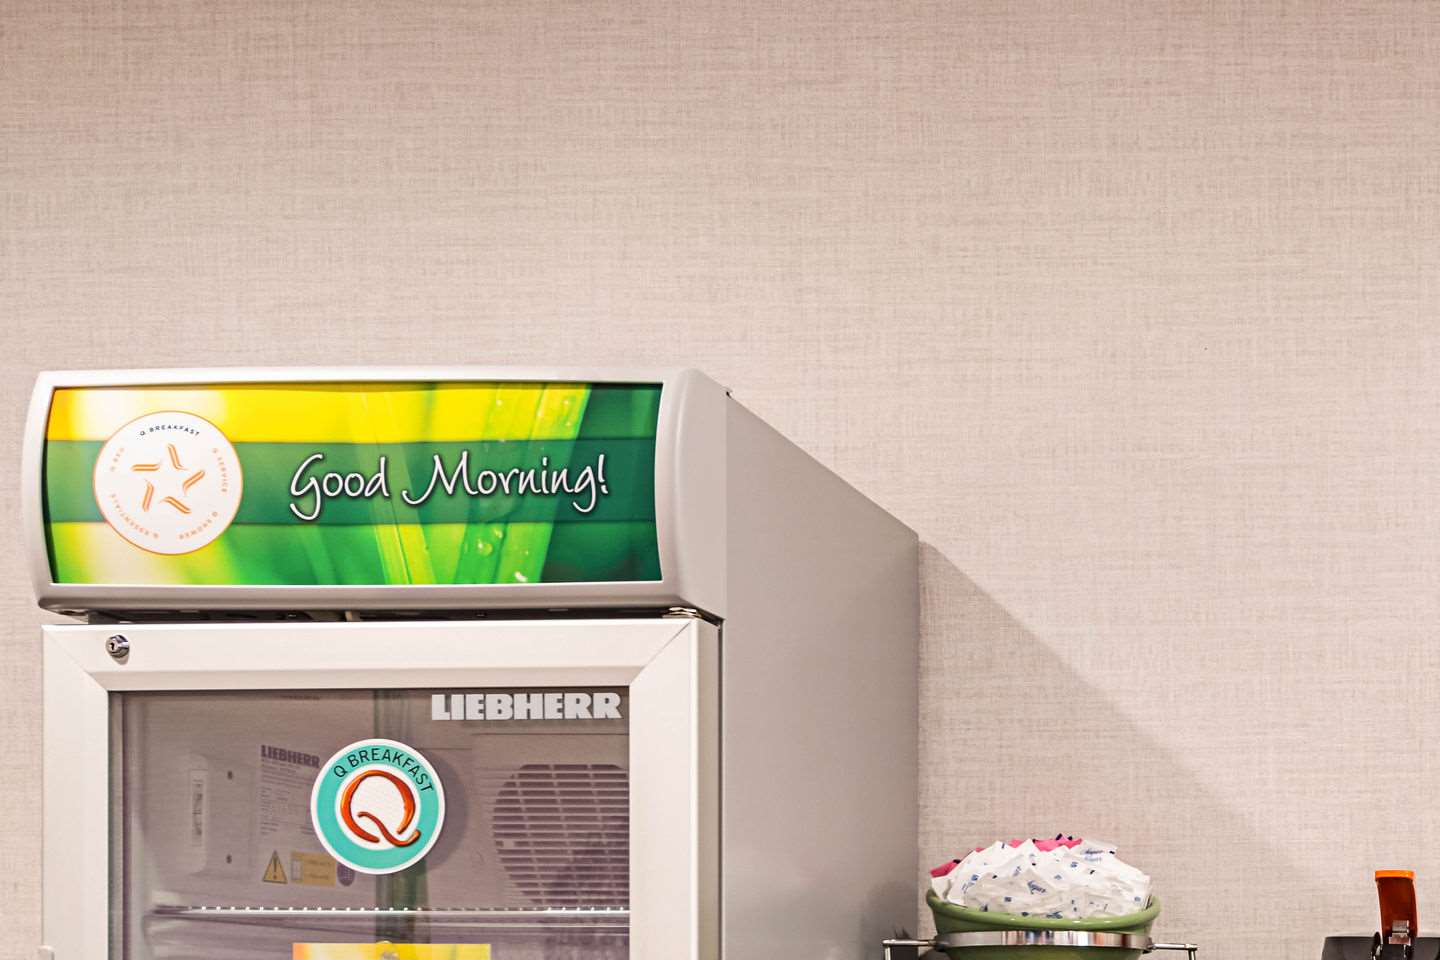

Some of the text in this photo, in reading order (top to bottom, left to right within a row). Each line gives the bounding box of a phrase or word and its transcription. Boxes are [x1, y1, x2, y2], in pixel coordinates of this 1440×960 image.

[289, 450, 609, 521] Good Morning!
[431, 692, 622, 720] LIEBHERR
[261, 744, 320, 768] LIEBHERR
[333, 747, 434, 791] Q BREAKFAST
[340, 769, 422, 847] Q
